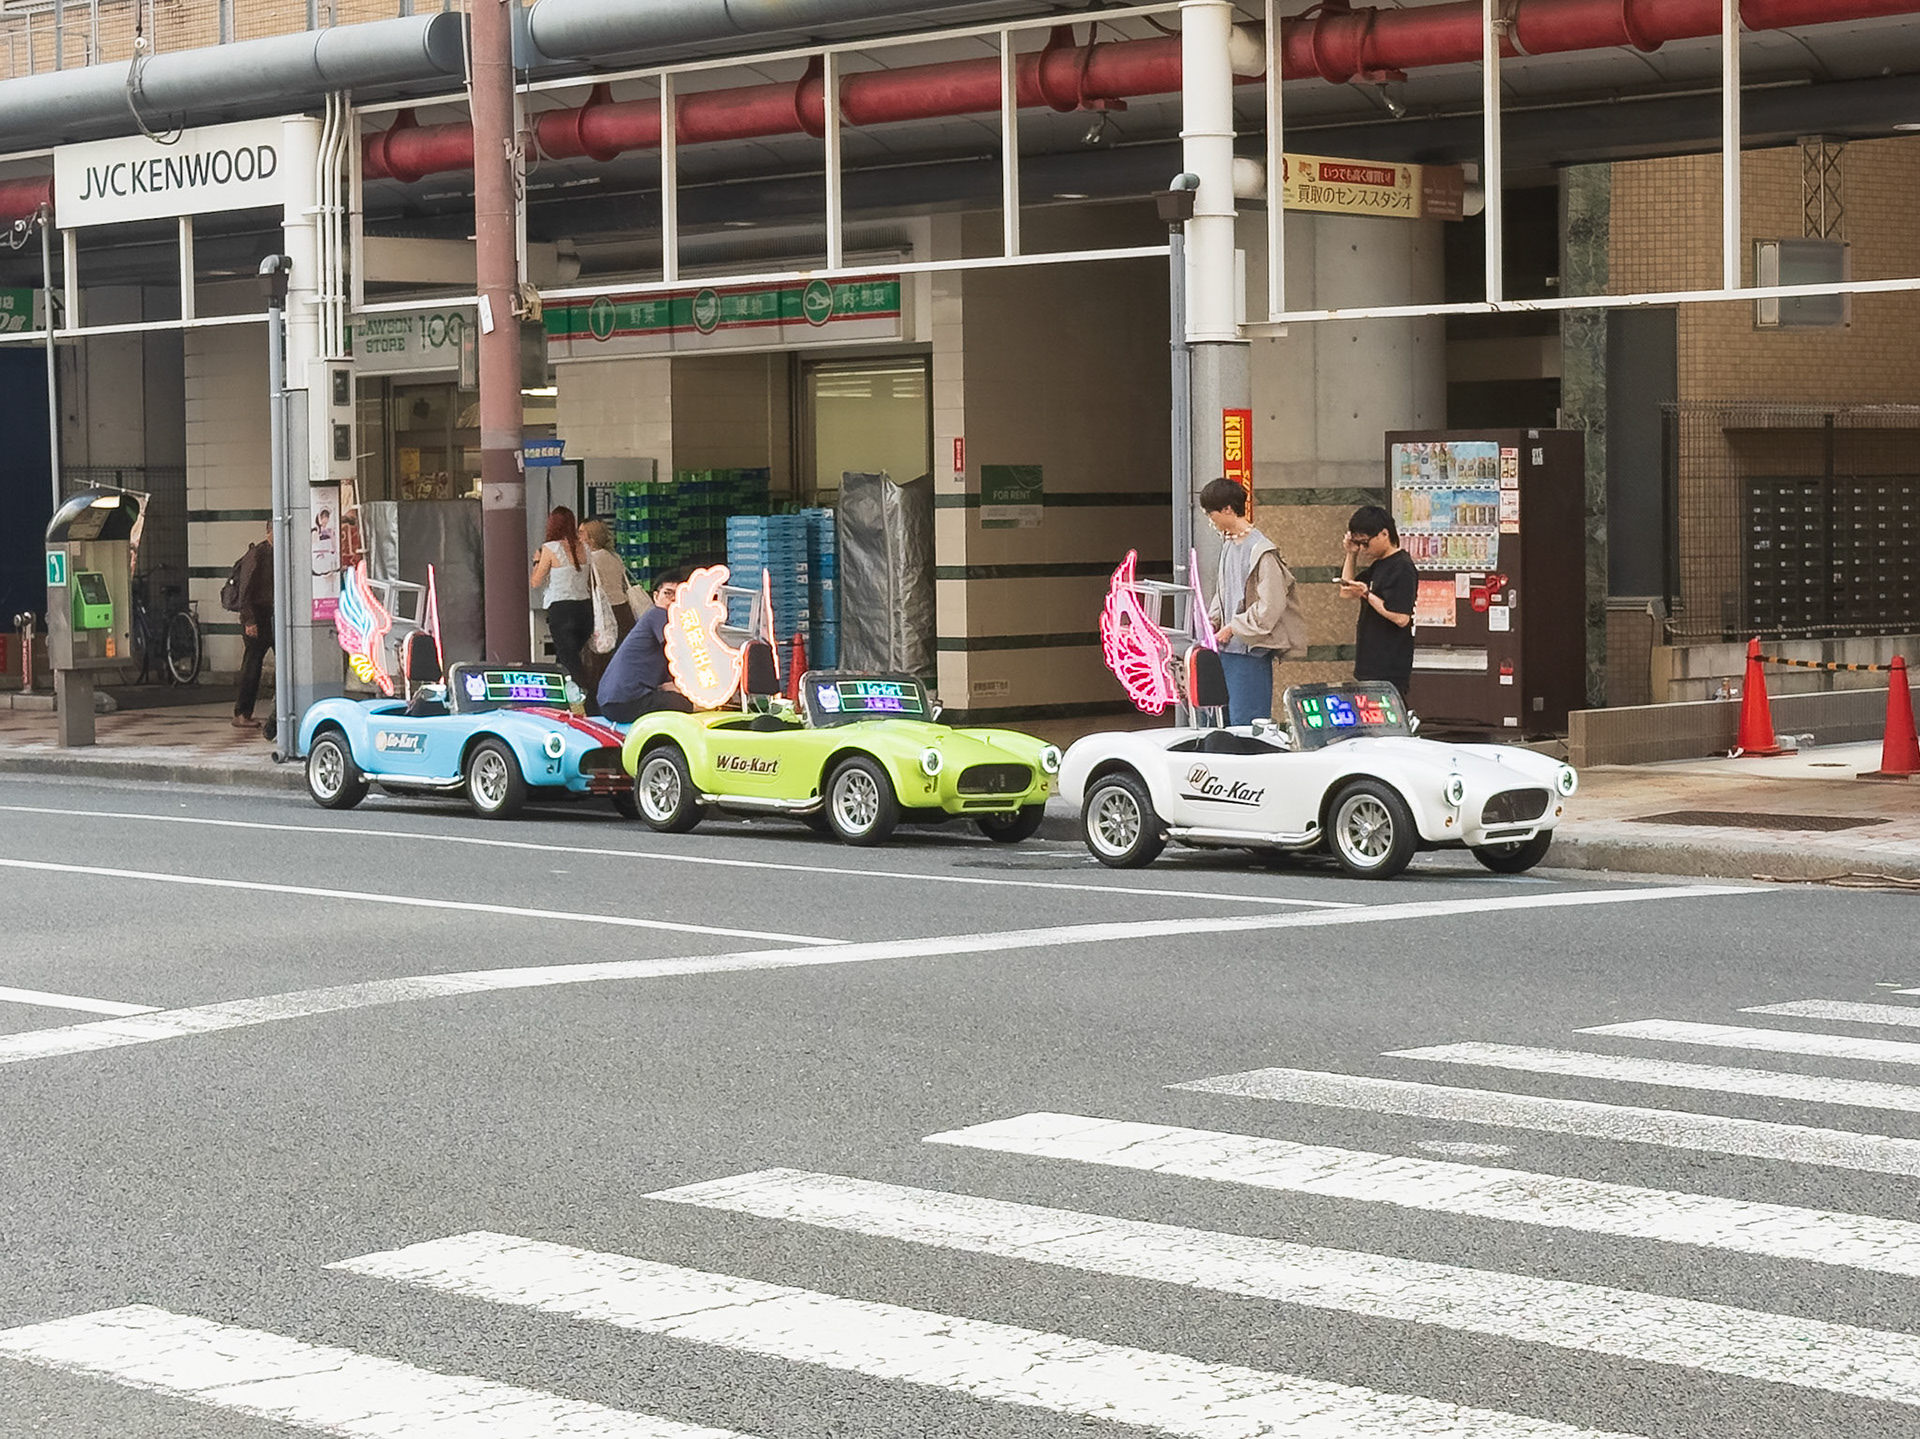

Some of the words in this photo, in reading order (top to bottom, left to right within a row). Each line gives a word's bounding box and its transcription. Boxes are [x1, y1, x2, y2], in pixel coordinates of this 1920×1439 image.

[79, 145, 277, 201] JVCKENWOOD
[1298, 184, 1413, 211] 買取のセンススタジオ
[357, 317, 413, 337] LAWSON
[365, 337, 406, 354] STORE
[1224, 415, 1242, 462] KIDS
[993, 490, 1009, 500] FOR
[1010, 490, 1031, 500] RENT
[716, 755, 730, 769] W
[730, 757, 779, 773] Go-Kart
[1201, 776, 1266, 802] Go-Kart
